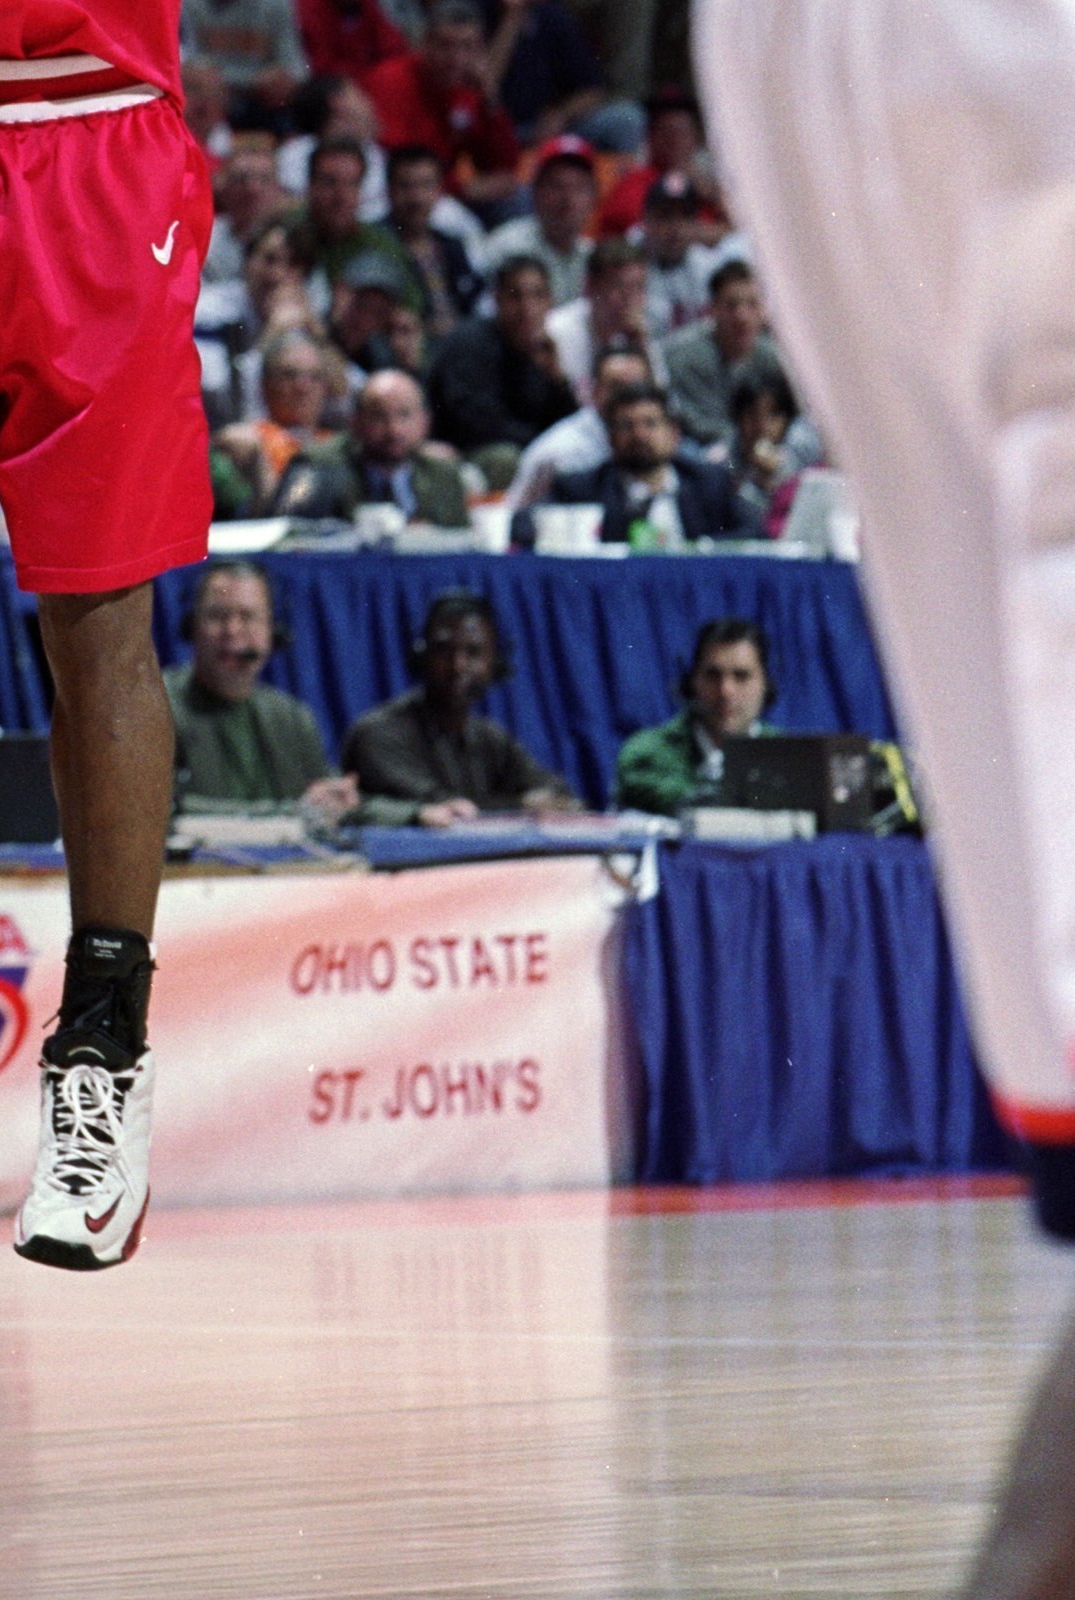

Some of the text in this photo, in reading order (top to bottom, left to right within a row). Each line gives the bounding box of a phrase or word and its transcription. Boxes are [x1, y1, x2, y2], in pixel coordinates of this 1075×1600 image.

[290, 934, 548, 995] OHIO STATE
[309, 1070, 370, 1124] ST.
